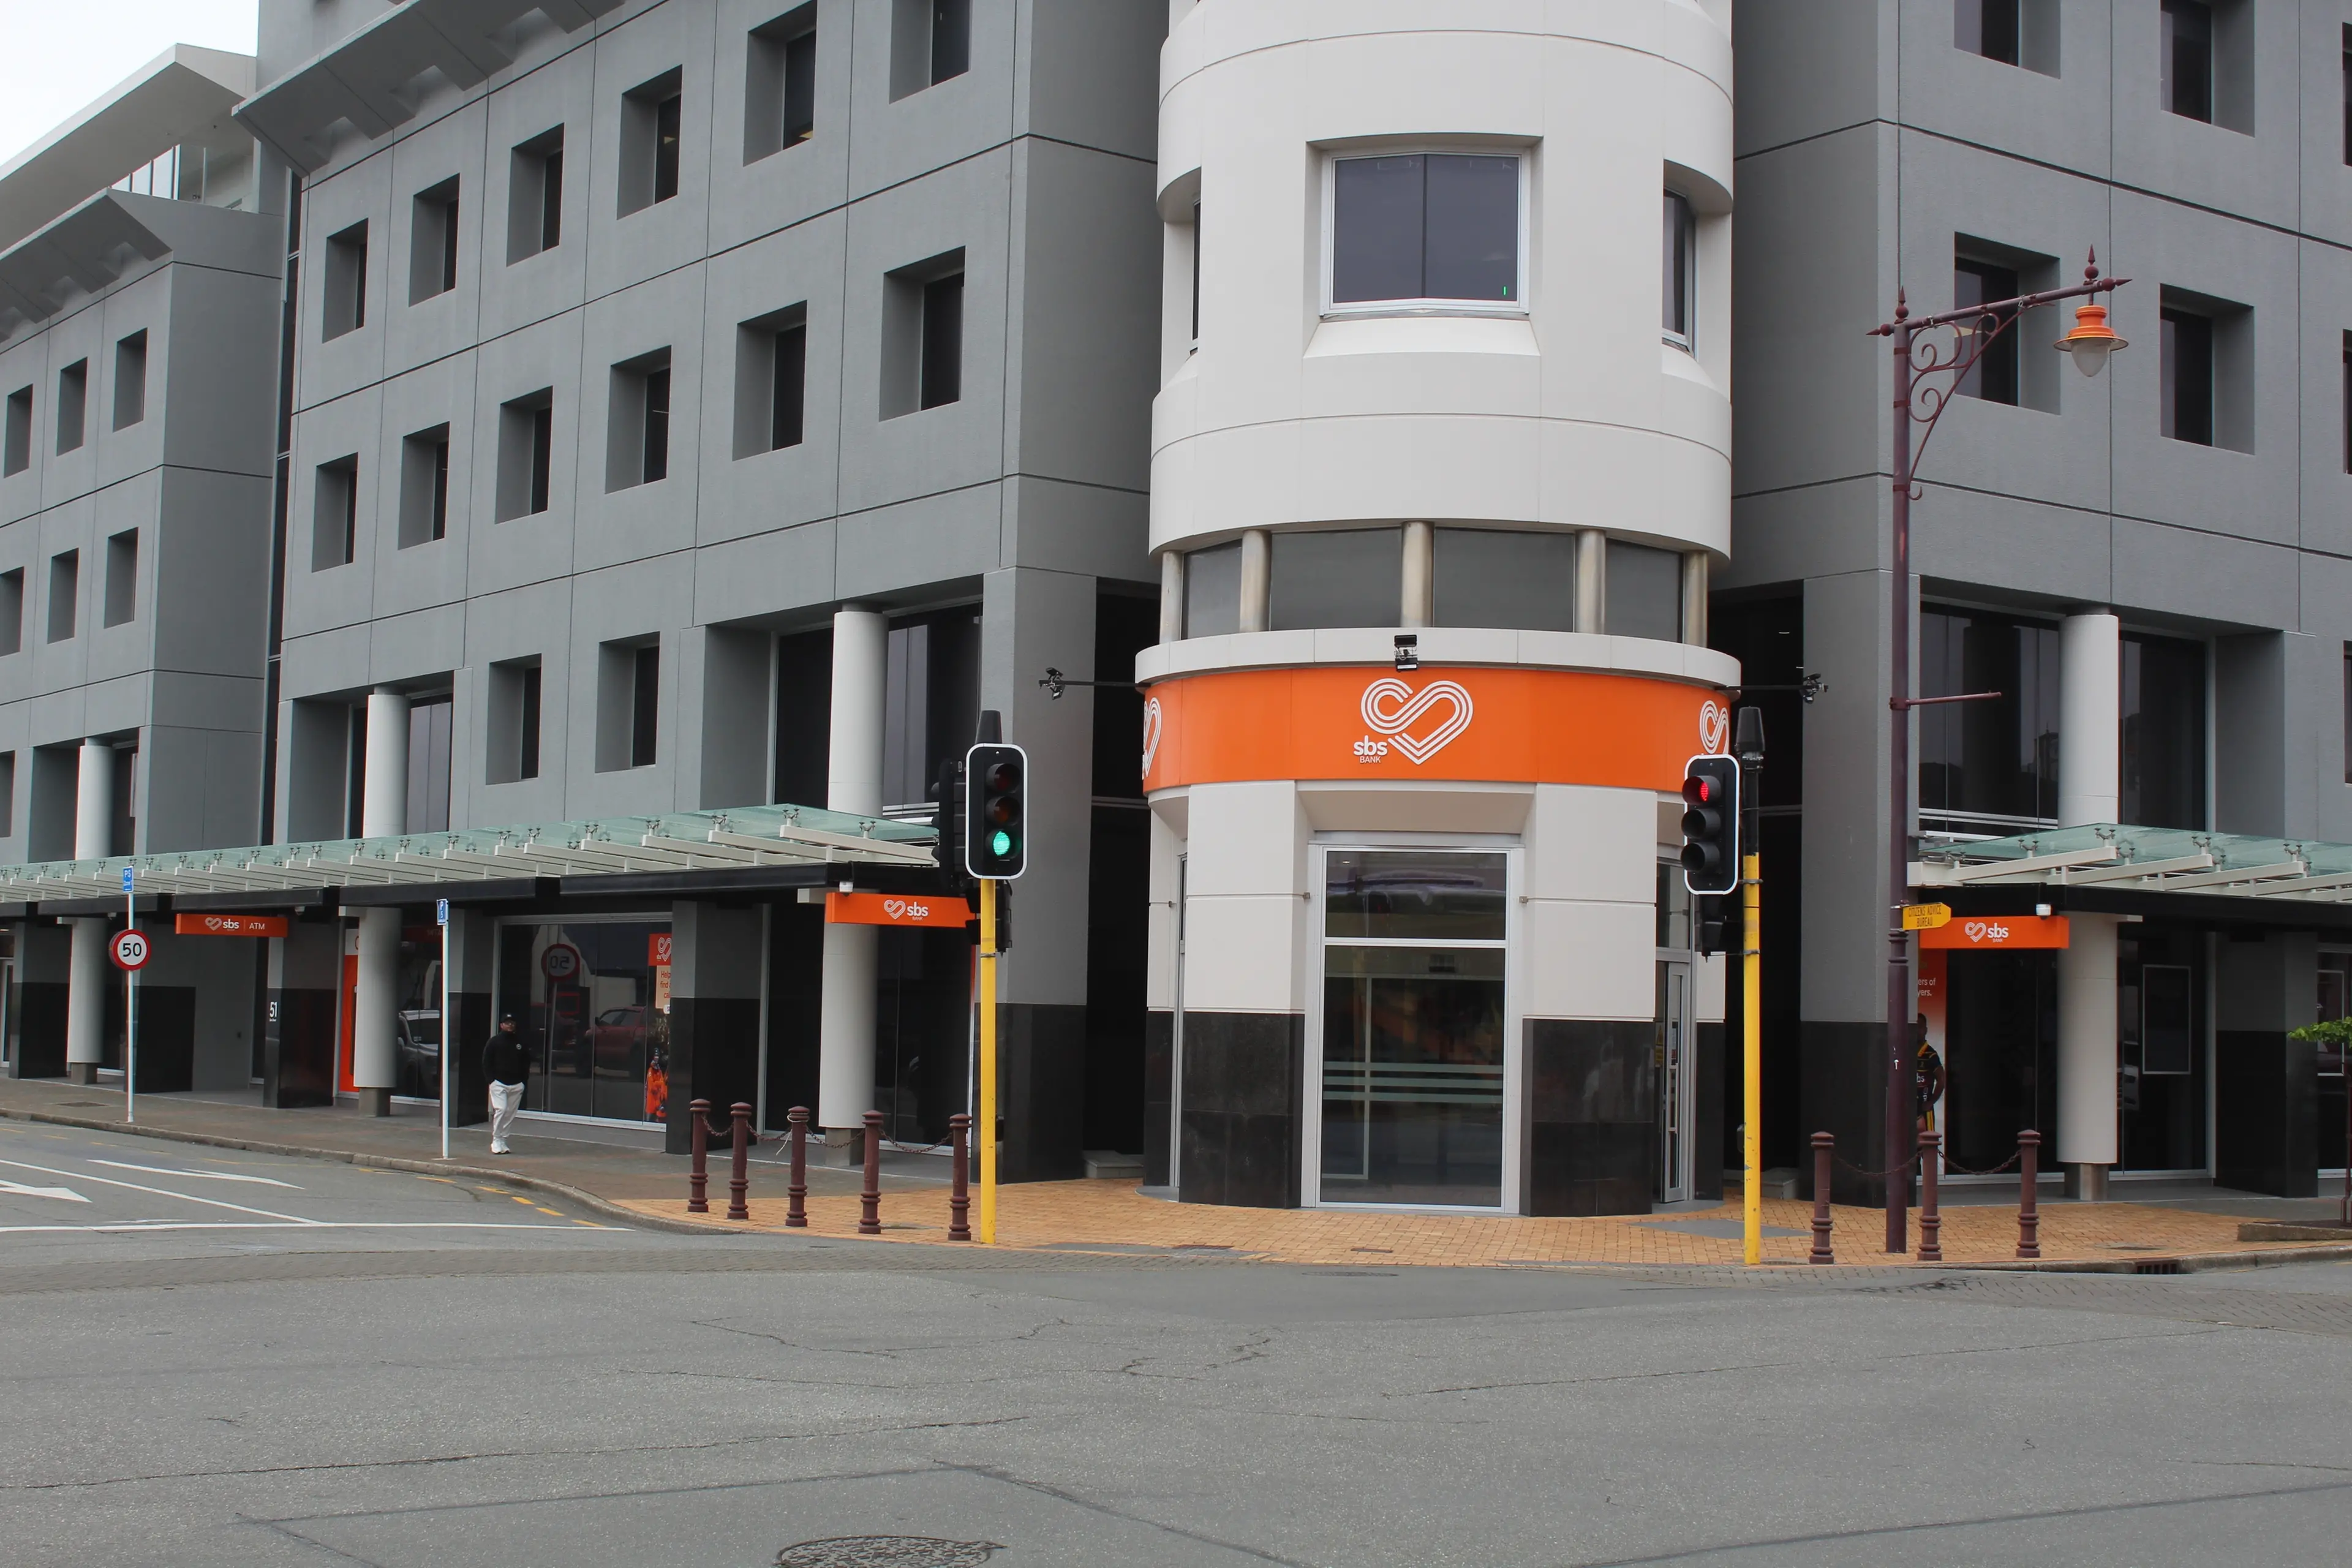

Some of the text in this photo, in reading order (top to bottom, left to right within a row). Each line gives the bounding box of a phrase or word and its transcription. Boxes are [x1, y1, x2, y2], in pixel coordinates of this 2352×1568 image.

[1353, 734, 1388, 756] sbs
[907, 901, 929, 917] sbs
[222, 918, 239, 929] sbs
[1987, 922, 2009, 938] sbs
[123, 943, 142, 957] 50
[270, 1001, 277, 1017] 51
